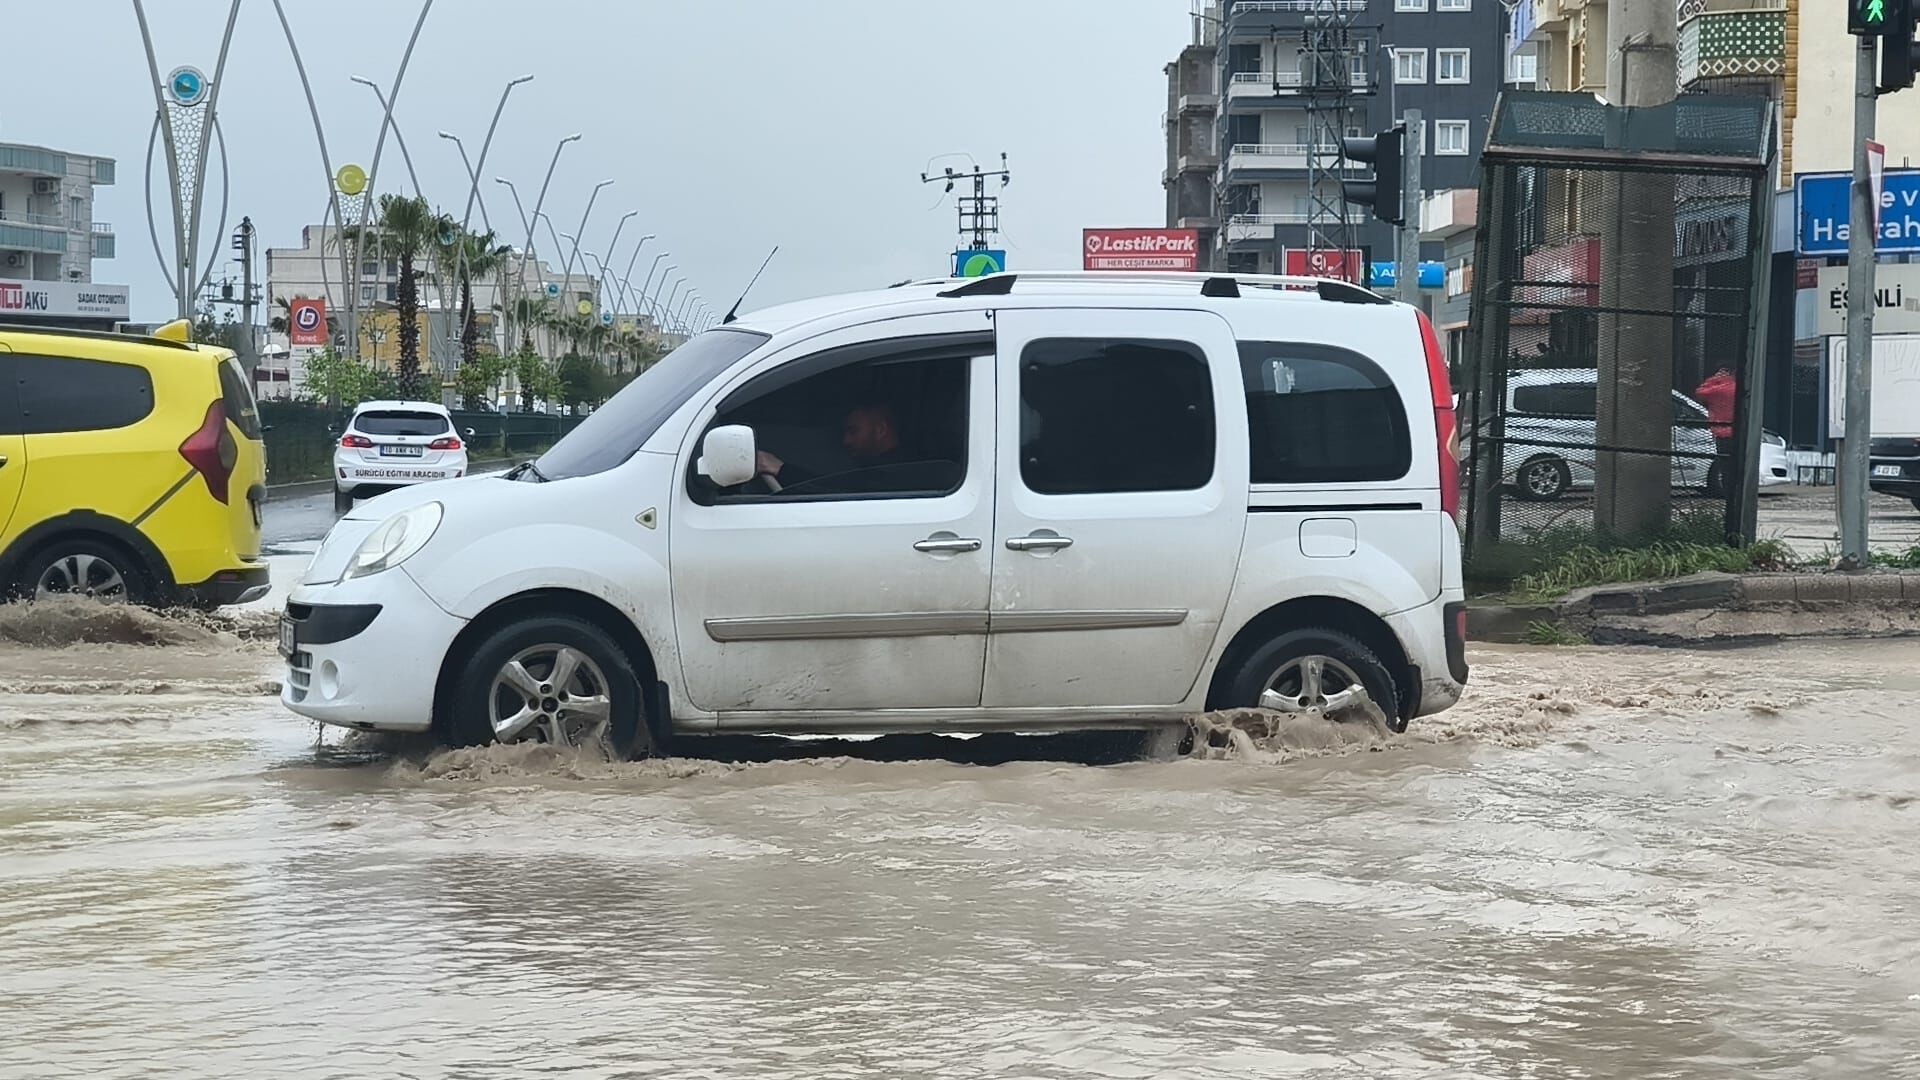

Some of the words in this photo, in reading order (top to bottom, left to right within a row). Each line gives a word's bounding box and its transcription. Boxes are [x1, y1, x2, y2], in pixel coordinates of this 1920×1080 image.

[1103, 235, 1195, 251] LastikPark
[1107, 259, 1123, 267] HER
[1147, 259, 1175, 267] MARKA
[0, 283, 22, 309] TLU
[1830, 284, 1902, 310] ESNLİ
